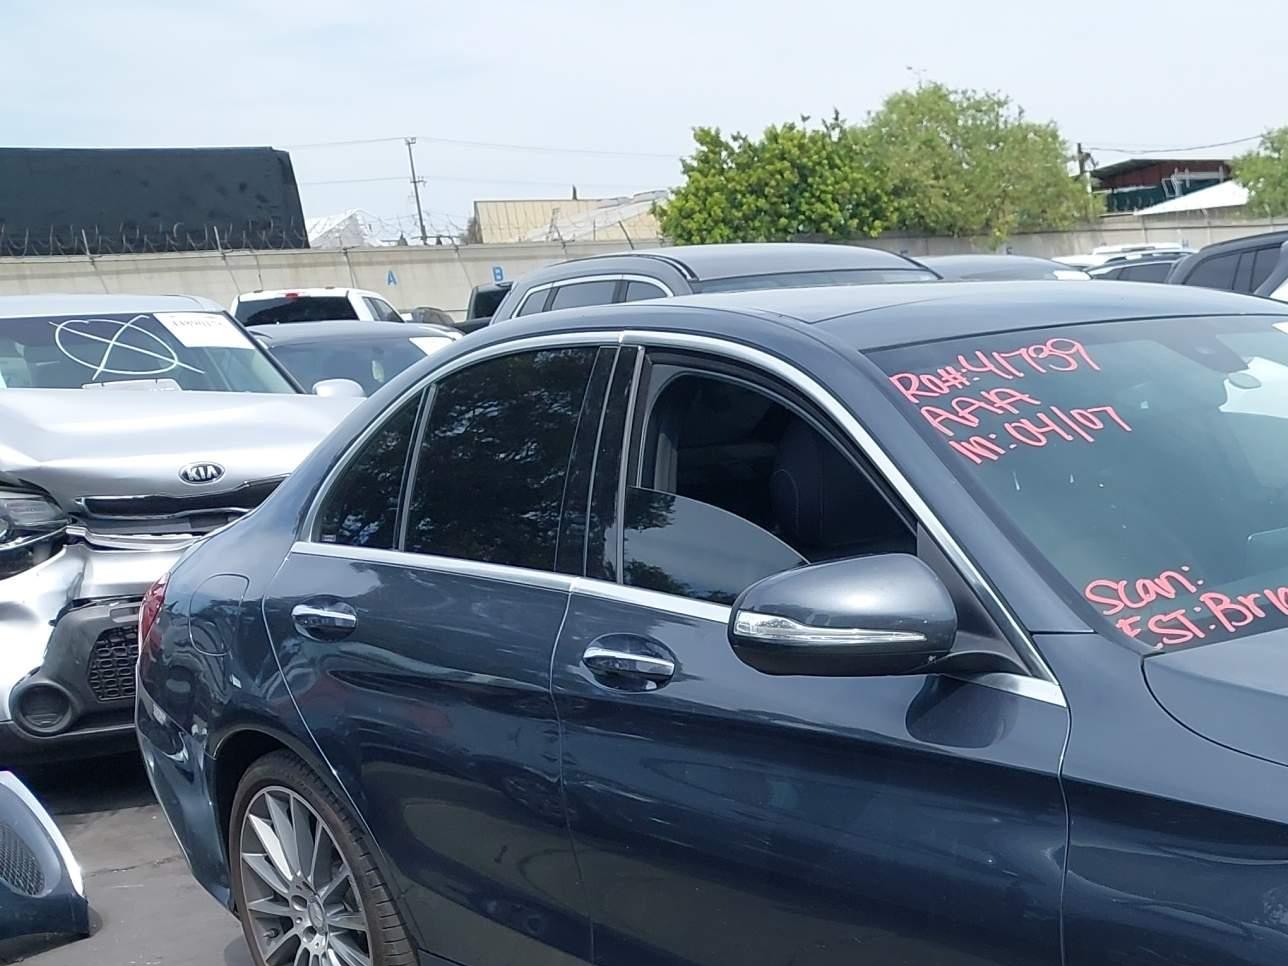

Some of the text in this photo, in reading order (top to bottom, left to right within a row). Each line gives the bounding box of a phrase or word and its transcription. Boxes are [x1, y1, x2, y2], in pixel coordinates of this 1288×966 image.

[387, 270, 397, 285] A
[492, 266, 503, 281] B
[187, 465, 218, 480] KIA
